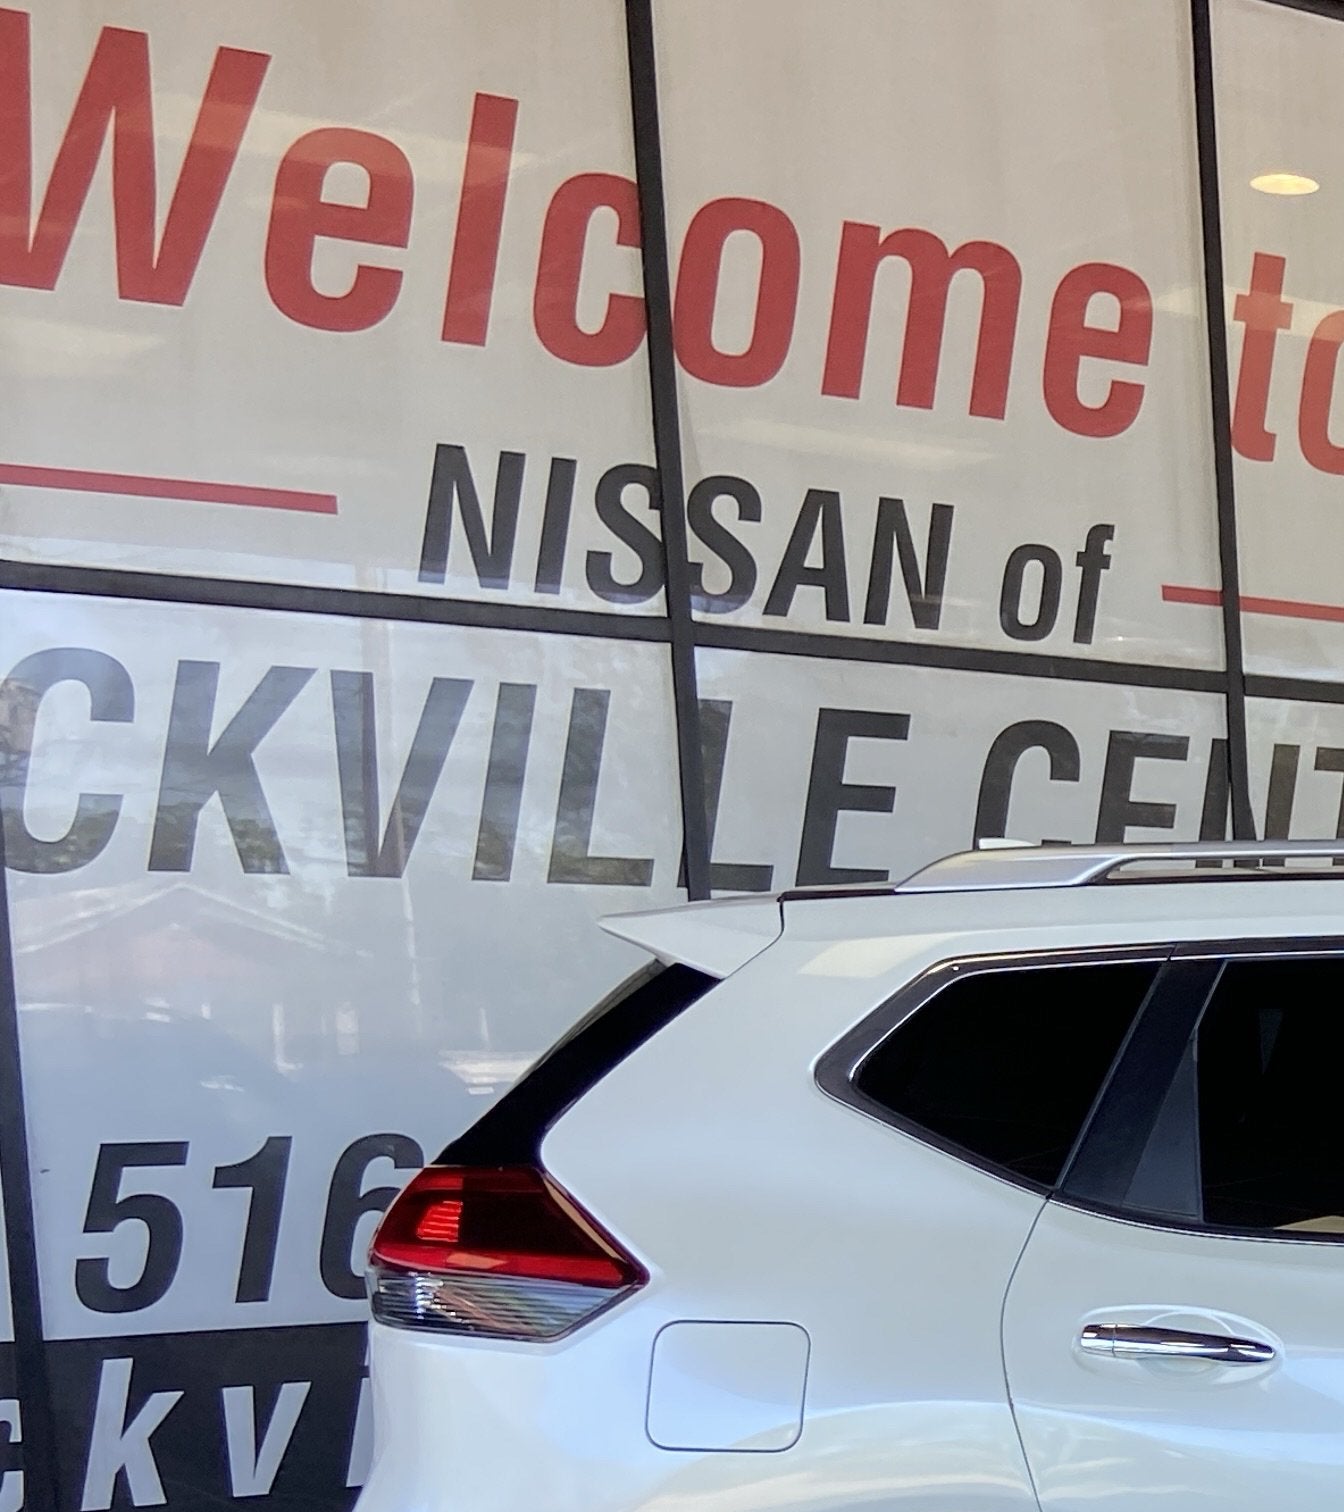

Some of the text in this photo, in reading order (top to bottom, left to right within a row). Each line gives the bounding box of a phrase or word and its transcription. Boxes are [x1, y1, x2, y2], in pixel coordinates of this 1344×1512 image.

[0, 7, 1154, 438] Welcome
[418, 443, 1115, 645] NISSAN of
[0, 646, 912, 892] CKVILLE
[74, 1132, 425, 1314] 516
